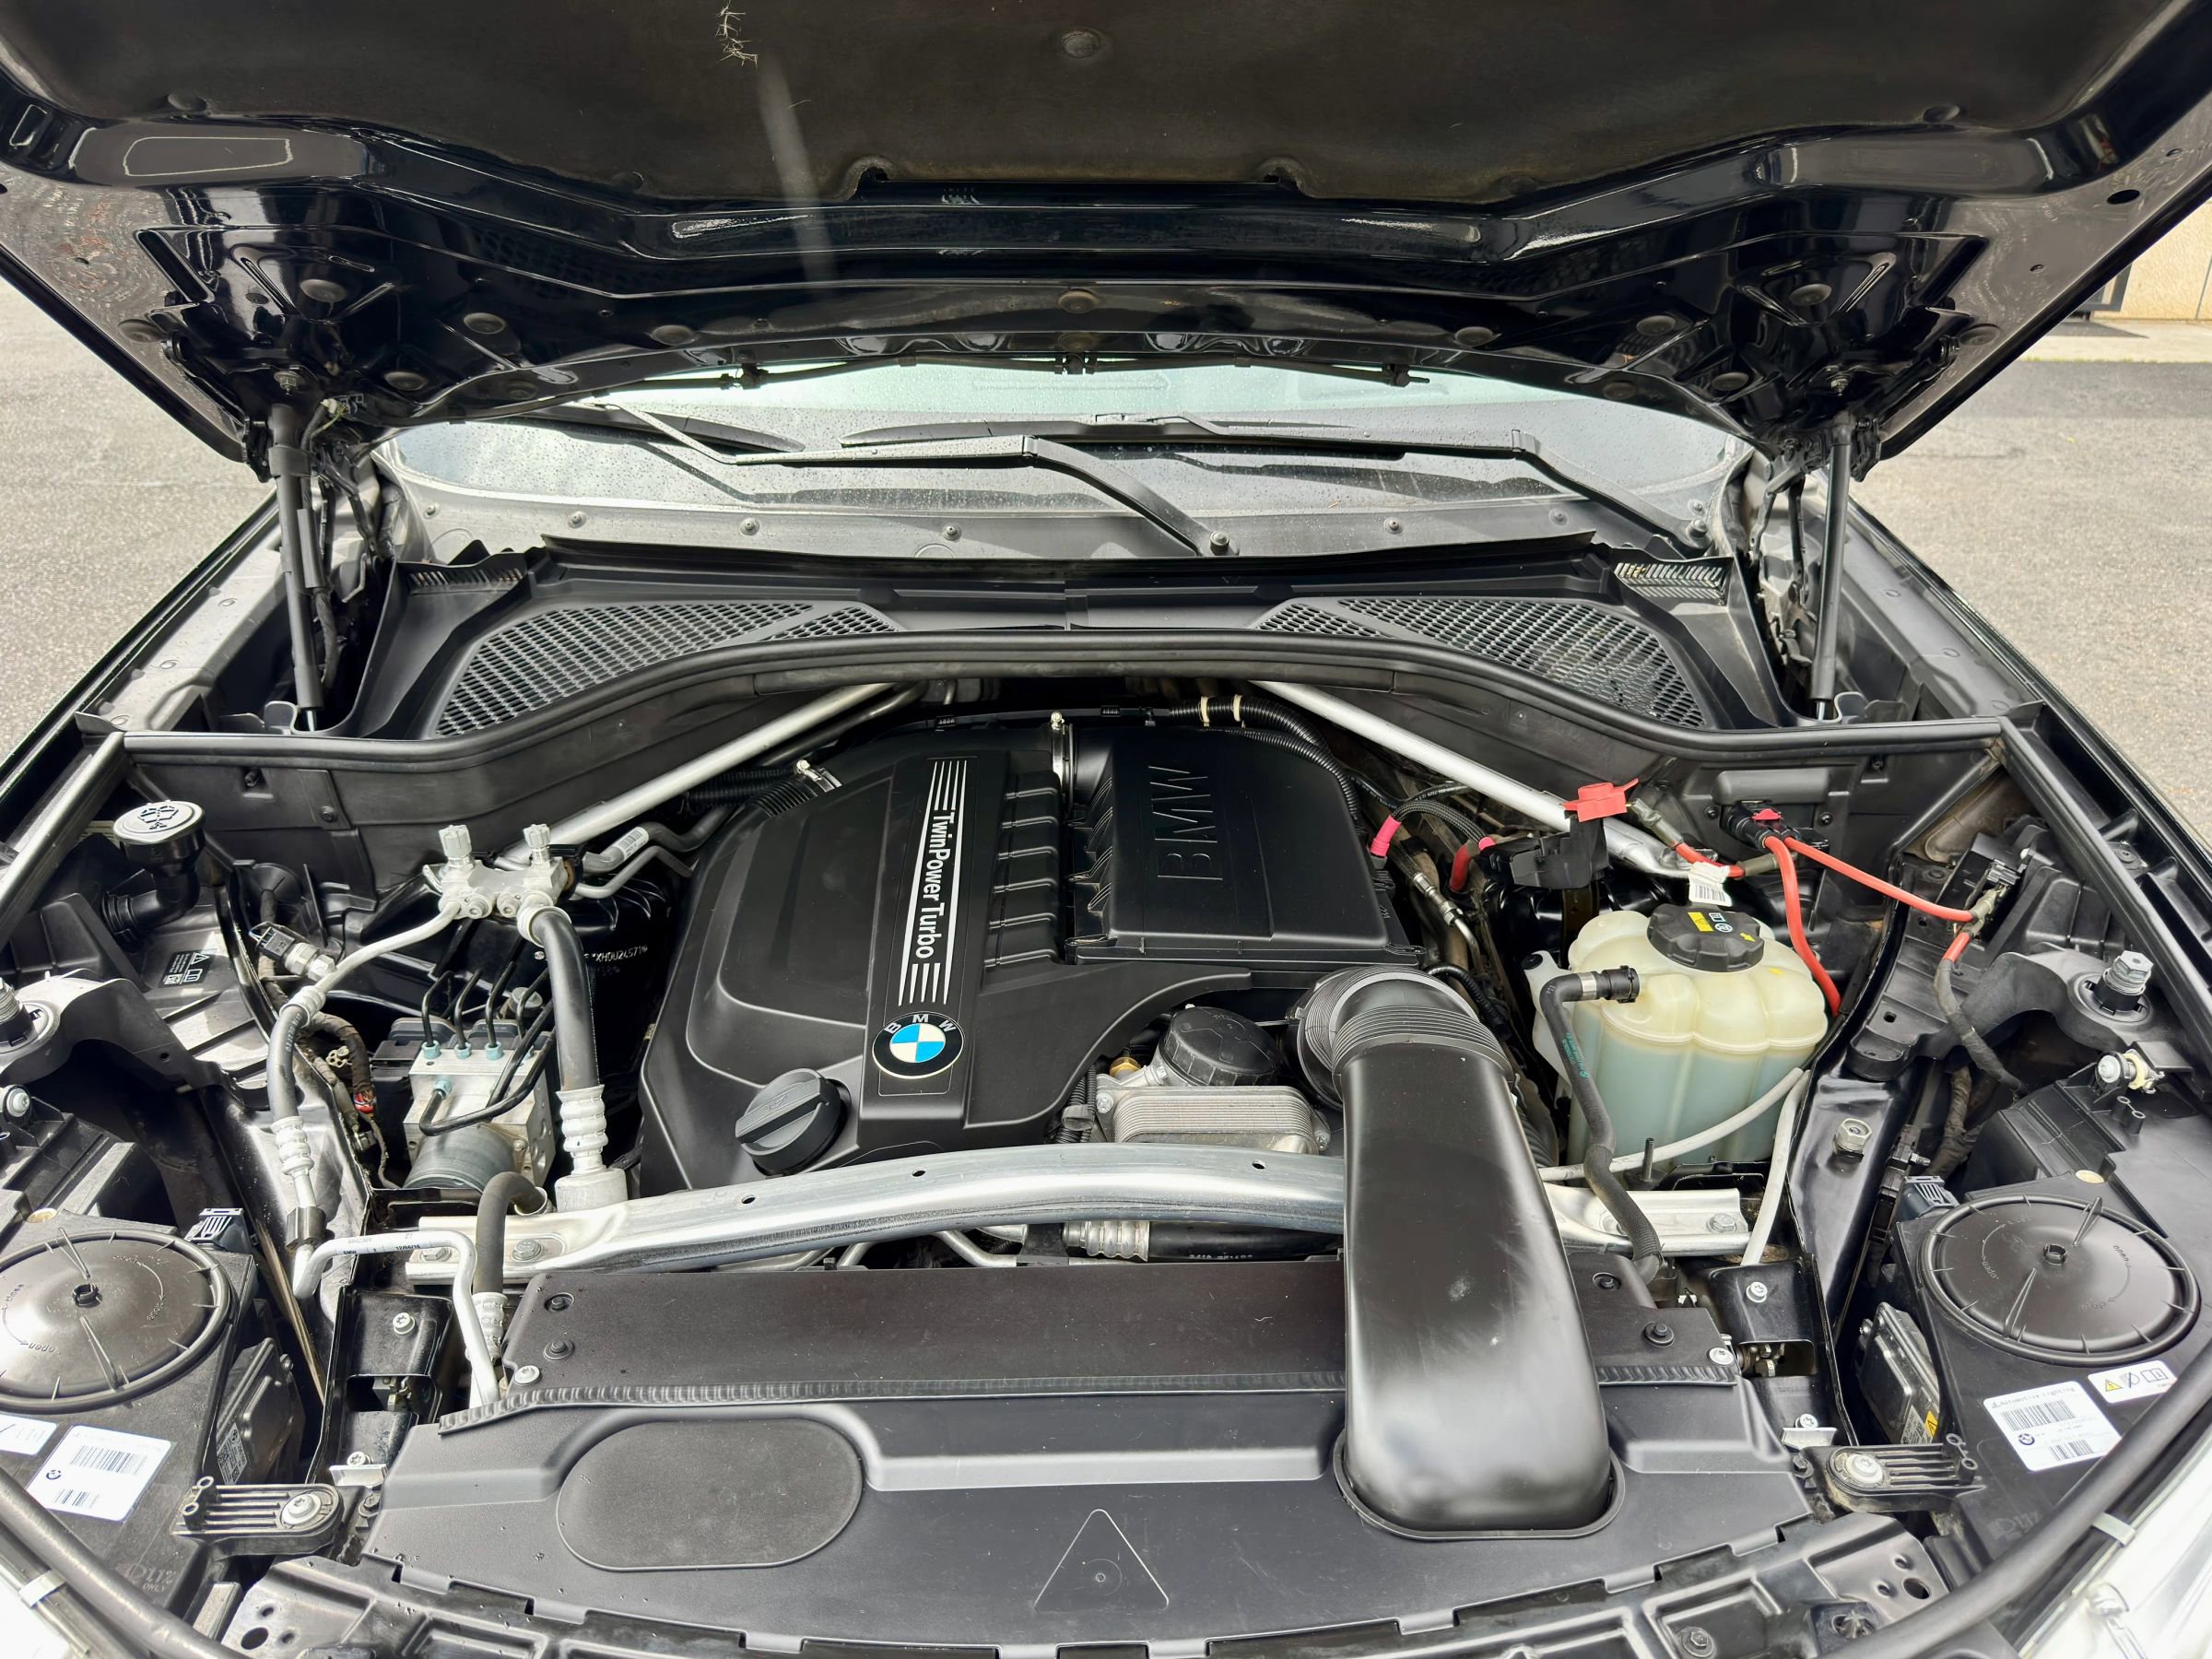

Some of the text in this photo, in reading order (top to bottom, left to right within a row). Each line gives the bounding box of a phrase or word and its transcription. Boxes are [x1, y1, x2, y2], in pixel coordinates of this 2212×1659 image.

[1147, 766, 1223, 880] BMW
[915, 811, 955, 959] TwinPower Turbo
[884, 1013, 957, 1034] BMW
[1983, 1261, 1997, 1278] open
[147, 1301, 165, 1321] close
[28, 1342, 56, 1353] open
